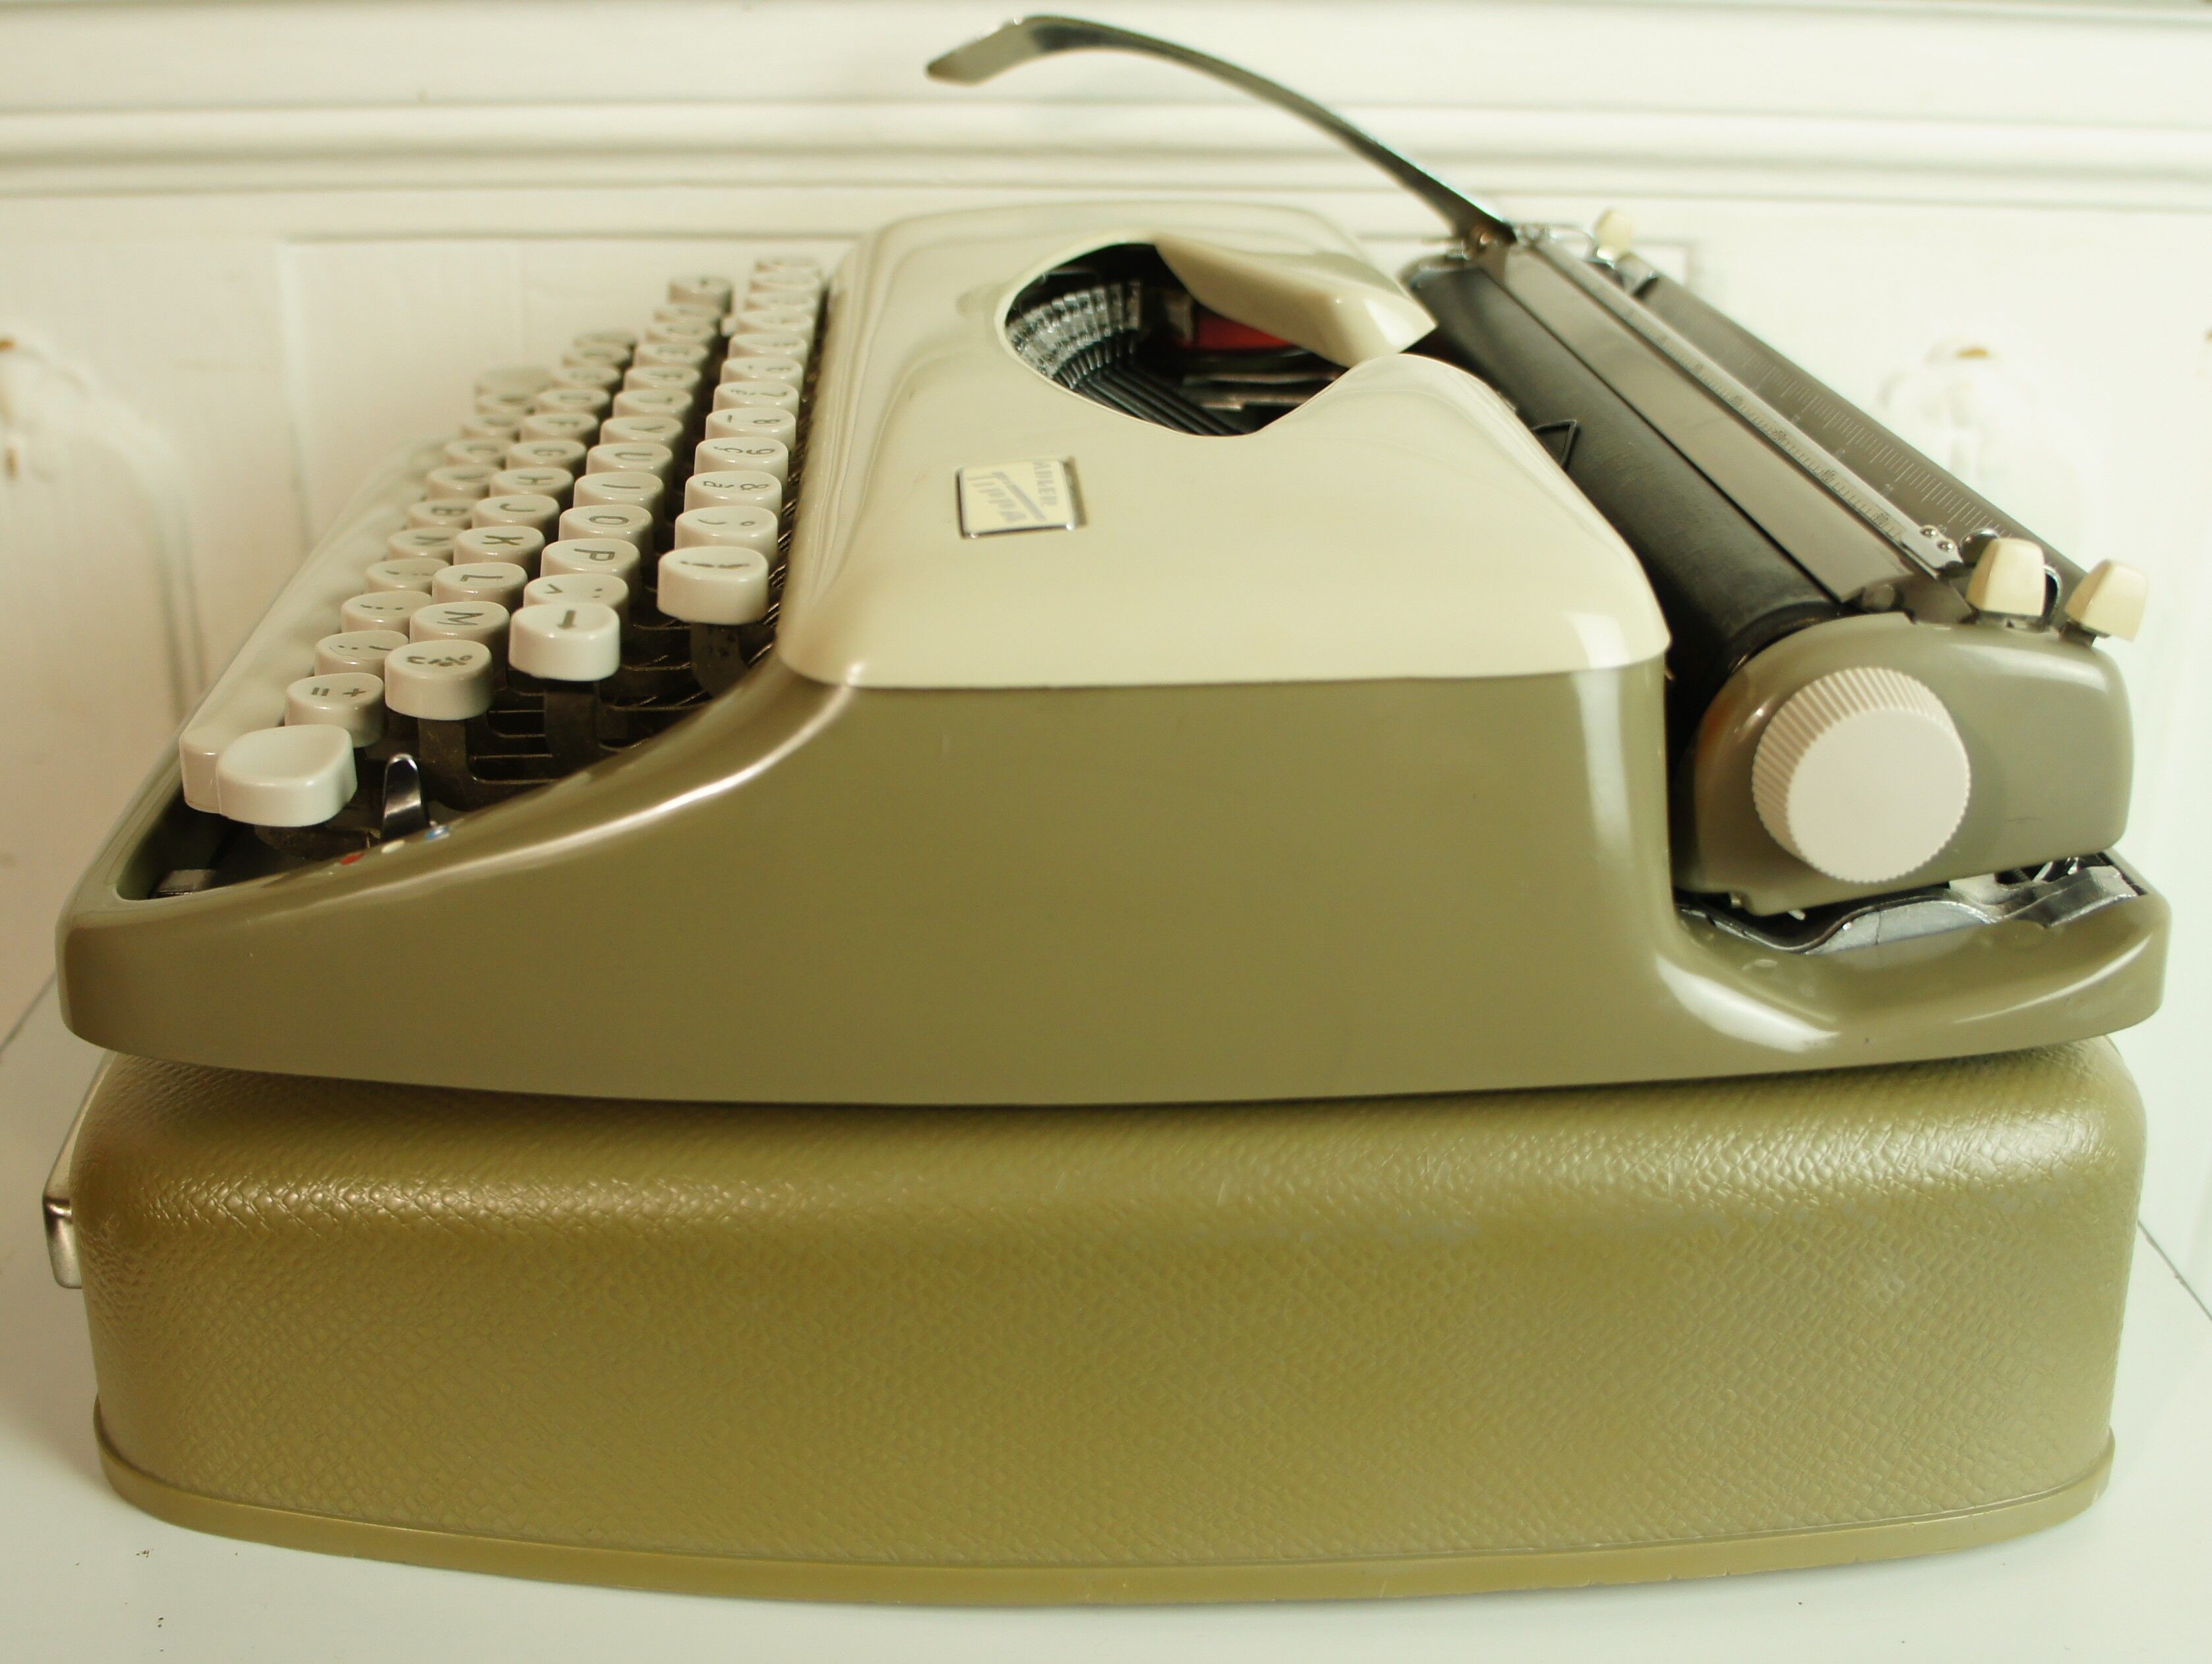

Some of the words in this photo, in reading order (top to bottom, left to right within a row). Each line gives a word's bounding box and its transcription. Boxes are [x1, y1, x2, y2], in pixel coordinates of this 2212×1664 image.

[614, 451, 653, 461] U
[499, 502, 537, 513] J
[481, 535, 525, 547] K
[573, 548, 616, 562] P
[460, 574, 504, 583] L
[436, 610, 485, 626] M
